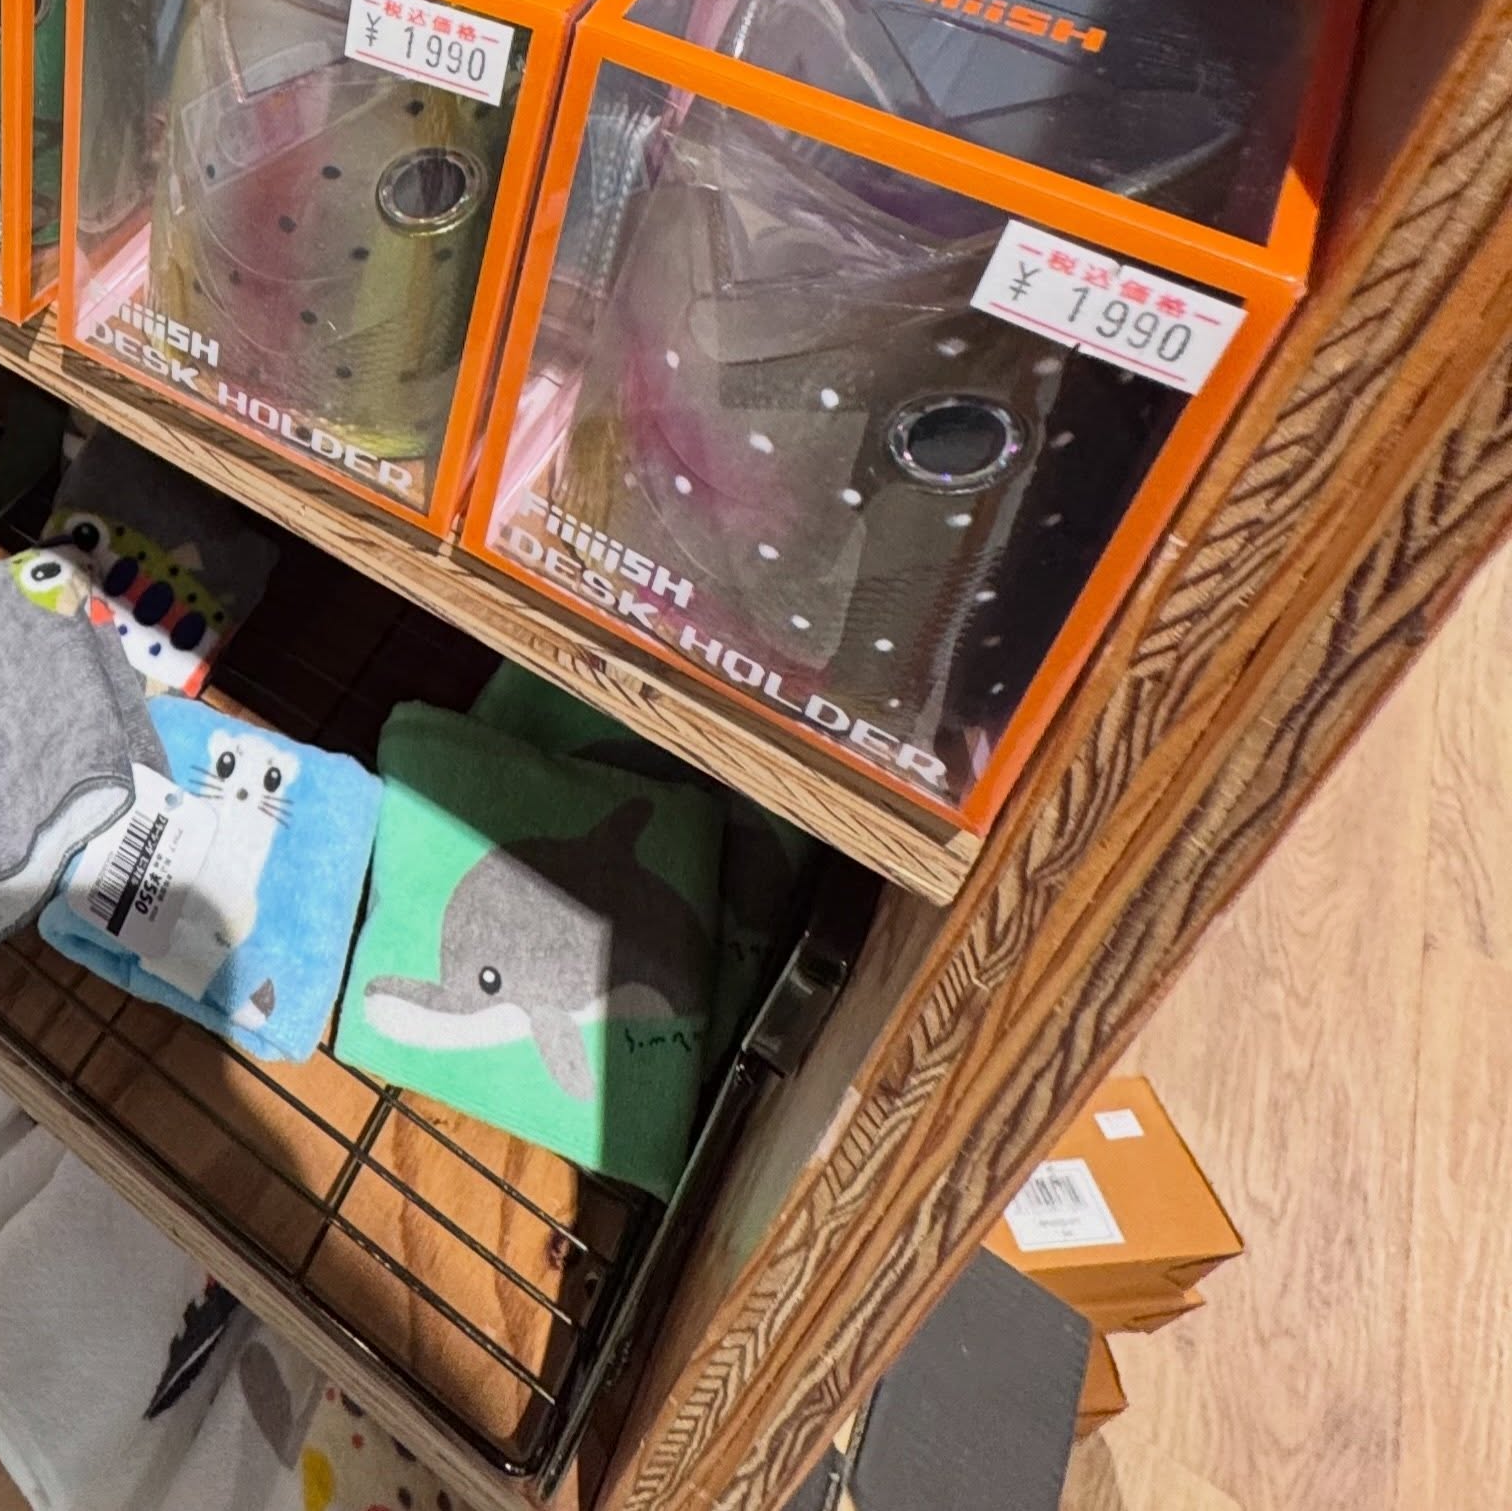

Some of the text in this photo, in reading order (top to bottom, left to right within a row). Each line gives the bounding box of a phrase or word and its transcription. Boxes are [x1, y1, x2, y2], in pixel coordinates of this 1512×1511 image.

[403, 26, 487, 82] 1990
[1066, 287, 1192, 363] 1990
[90, 320, 413, 496] DESK HOLDER
[507, 525, 950, 789] DESK HOLDER
[134, 871, 163, 915] ¥550
